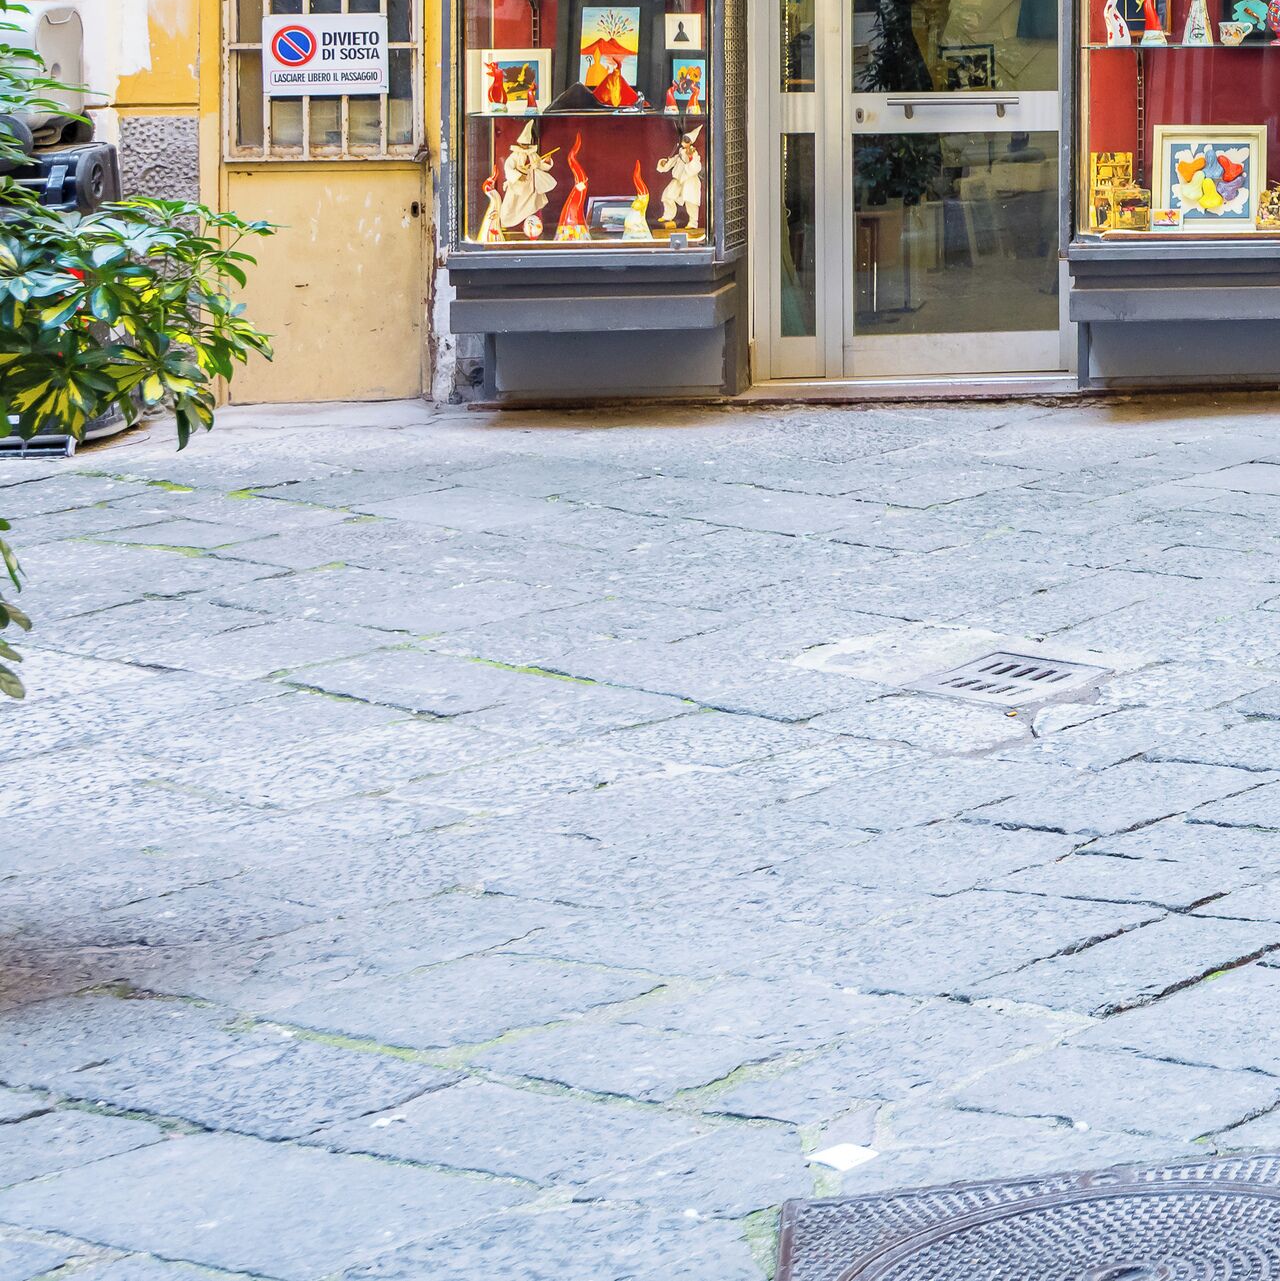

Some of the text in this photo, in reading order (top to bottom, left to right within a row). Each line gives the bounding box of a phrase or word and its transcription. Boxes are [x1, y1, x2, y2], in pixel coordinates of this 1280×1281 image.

[322, 31, 380, 46] DIVIETO
[322, 48, 380, 61] DI SOSTA
[274, 71, 378, 83] LASCIARE LIBERO IL PASSAGGIO
